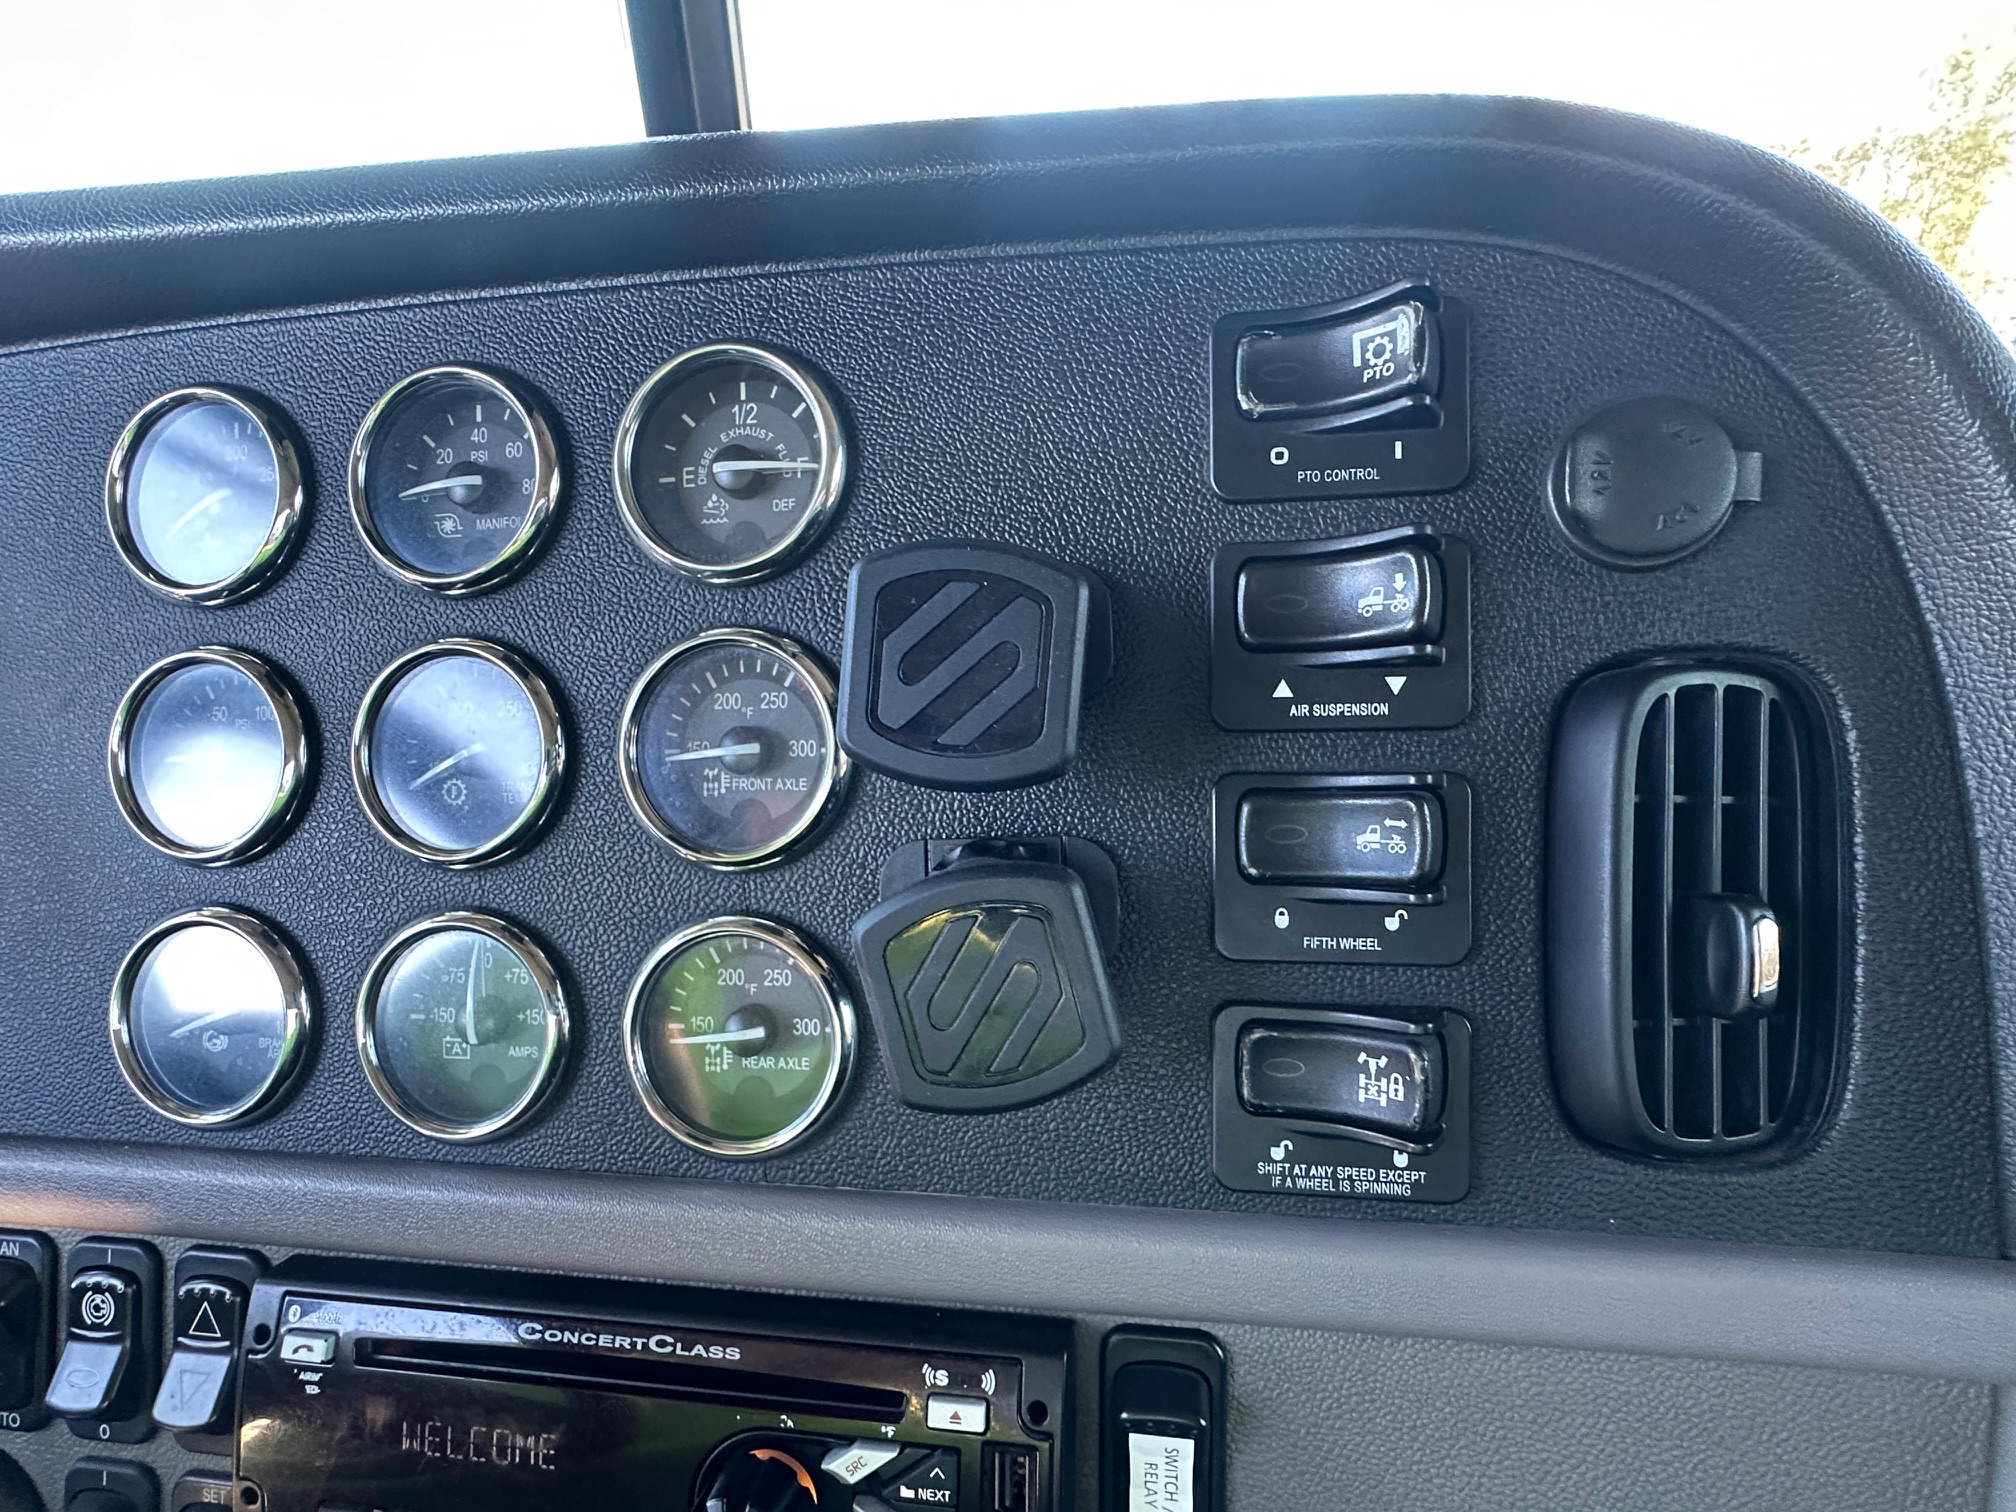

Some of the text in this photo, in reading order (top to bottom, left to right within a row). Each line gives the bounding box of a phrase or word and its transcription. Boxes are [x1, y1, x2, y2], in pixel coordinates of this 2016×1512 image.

[1363, 362, 1395, 383] PTO
[731, 403, 758, 425] 1/2
[470, 427, 488, 443] 40
[436, 448, 453, 465] 20
[470, 450, 488, 462] PSI
[505, 442, 523, 458] 60
[697, 445, 718, 485] DIESEL
[719, 426, 775, 443] EXHAUST
[683, 467, 695, 487] E
[1297, 468, 1380, 483] PTO CONTROL
[773, 499, 796, 511] DEF
[714, 693, 741, 710] 200
[760, 692, 788, 709] 250
[1290, 703, 1389, 717] AIR SUSPENSION
[789, 740, 817, 757] 300
[732, 778, 808, 791] FRONT AXLE
[1303, 937, 1382, 951] FIFTH WHEEL
[504, 968, 529, 985] +75
[717, 968, 745, 986] 200
[764, 969, 792, 986] 250
[690, 1016, 714, 1033] 150
[793, 1018, 821, 1036] 300
[508, 1046, 539, 1058] AMPS
[742, 1056, 810, 1070] REAR AXLE
[1257, 1162, 1427, 1184] SHIFT AT ANY SPEED EXCEPT
[1272, 1176, 1411, 1196] IF A WHEEL IS SPINNING
[402, 1420, 558, 1470] WELCOME
[845, 1456, 868, 1477] SRC
[1164, 1447, 1180, 1502] SWITCH
[1144, 1462, 1159, 1509] RELAY
[202, 1488, 227, 1504] SET
[918, 1488, 951, 1502] NEXT
